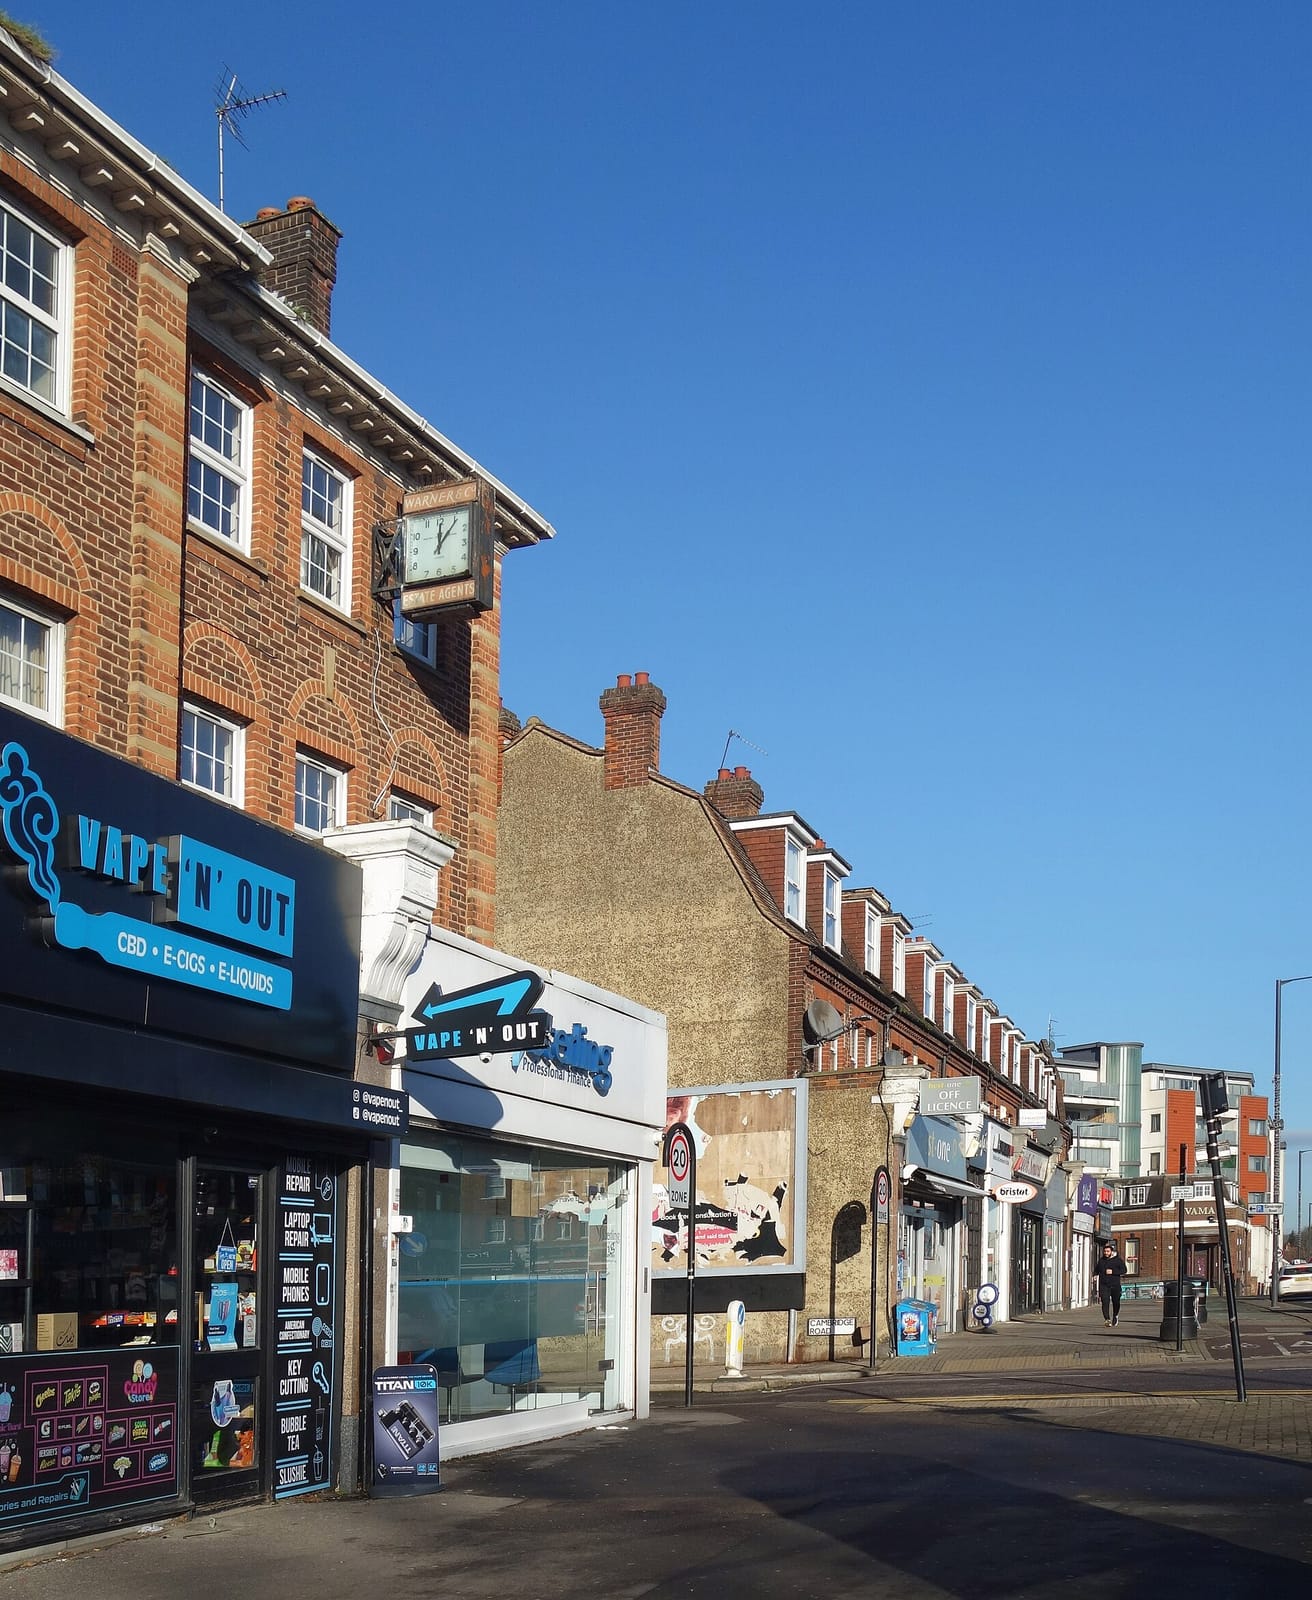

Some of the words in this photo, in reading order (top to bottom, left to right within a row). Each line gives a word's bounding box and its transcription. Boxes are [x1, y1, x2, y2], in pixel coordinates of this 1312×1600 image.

[404, 490, 455, 508] WARNER
[412, 533, 420, 541] 10
[412, 547, 418, 555] 9
[412, 562, 418, 570] 8
[402, 591, 435, 605] ESTATE
[438, 582, 475, 599] AGENTS
[78, 814, 168, 895] VAPE
[236, 879, 290, 936] OUT
[118, 931, 147, 957] CBD
[163, 945, 205, 975] E-CIGS
[218, 961, 273, 994] E-LIQUIDS
[414, 1030, 462, 1051] VAPE
[502, 1021, 539, 1041] OUT
[522, 1057, 565, 1081] Professional
[567, 1068, 591, 1088] Finance
[938, 1090, 960, 1100] OFF
[927, 1101, 972, 1112] LICENCE
[362, 1108, 400, 1127] @vapenout
[673, 1148, 686, 1168] 20
[286, 1174, 311, 1193] REPAIR
[671, 1190, 687, 1203] ZONE
[1184, 1206, 1215, 1215] VAMA
[284, 1211, 311, 1229] LAPTOP
[284, 1230, 309, 1247] REPAIR
[283, 1267, 309, 1284] MOBILE
[282, 1286, 310, 1303] PHONES
[284, 1320, 305, 1330] AMERICAN
[809, 1319, 854, 1327] CAMBRIDGE
[809, 1327, 832, 1335] ROAD
[287, 1359, 302, 1376] KEY
[124, 1381, 157, 1396] Candy
[279, 1377, 309, 1395] CUTTING
[374, 1380, 415, 1391] TITAN
[281, 1415, 307, 1434] BUBBLE
[287, 1434, 300, 1451] TEA
[279, 1464, 307, 1485] SLUSHIE
[21, 1498, 37, 1508] and
[38, 1492, 69, 1504] Repairs
